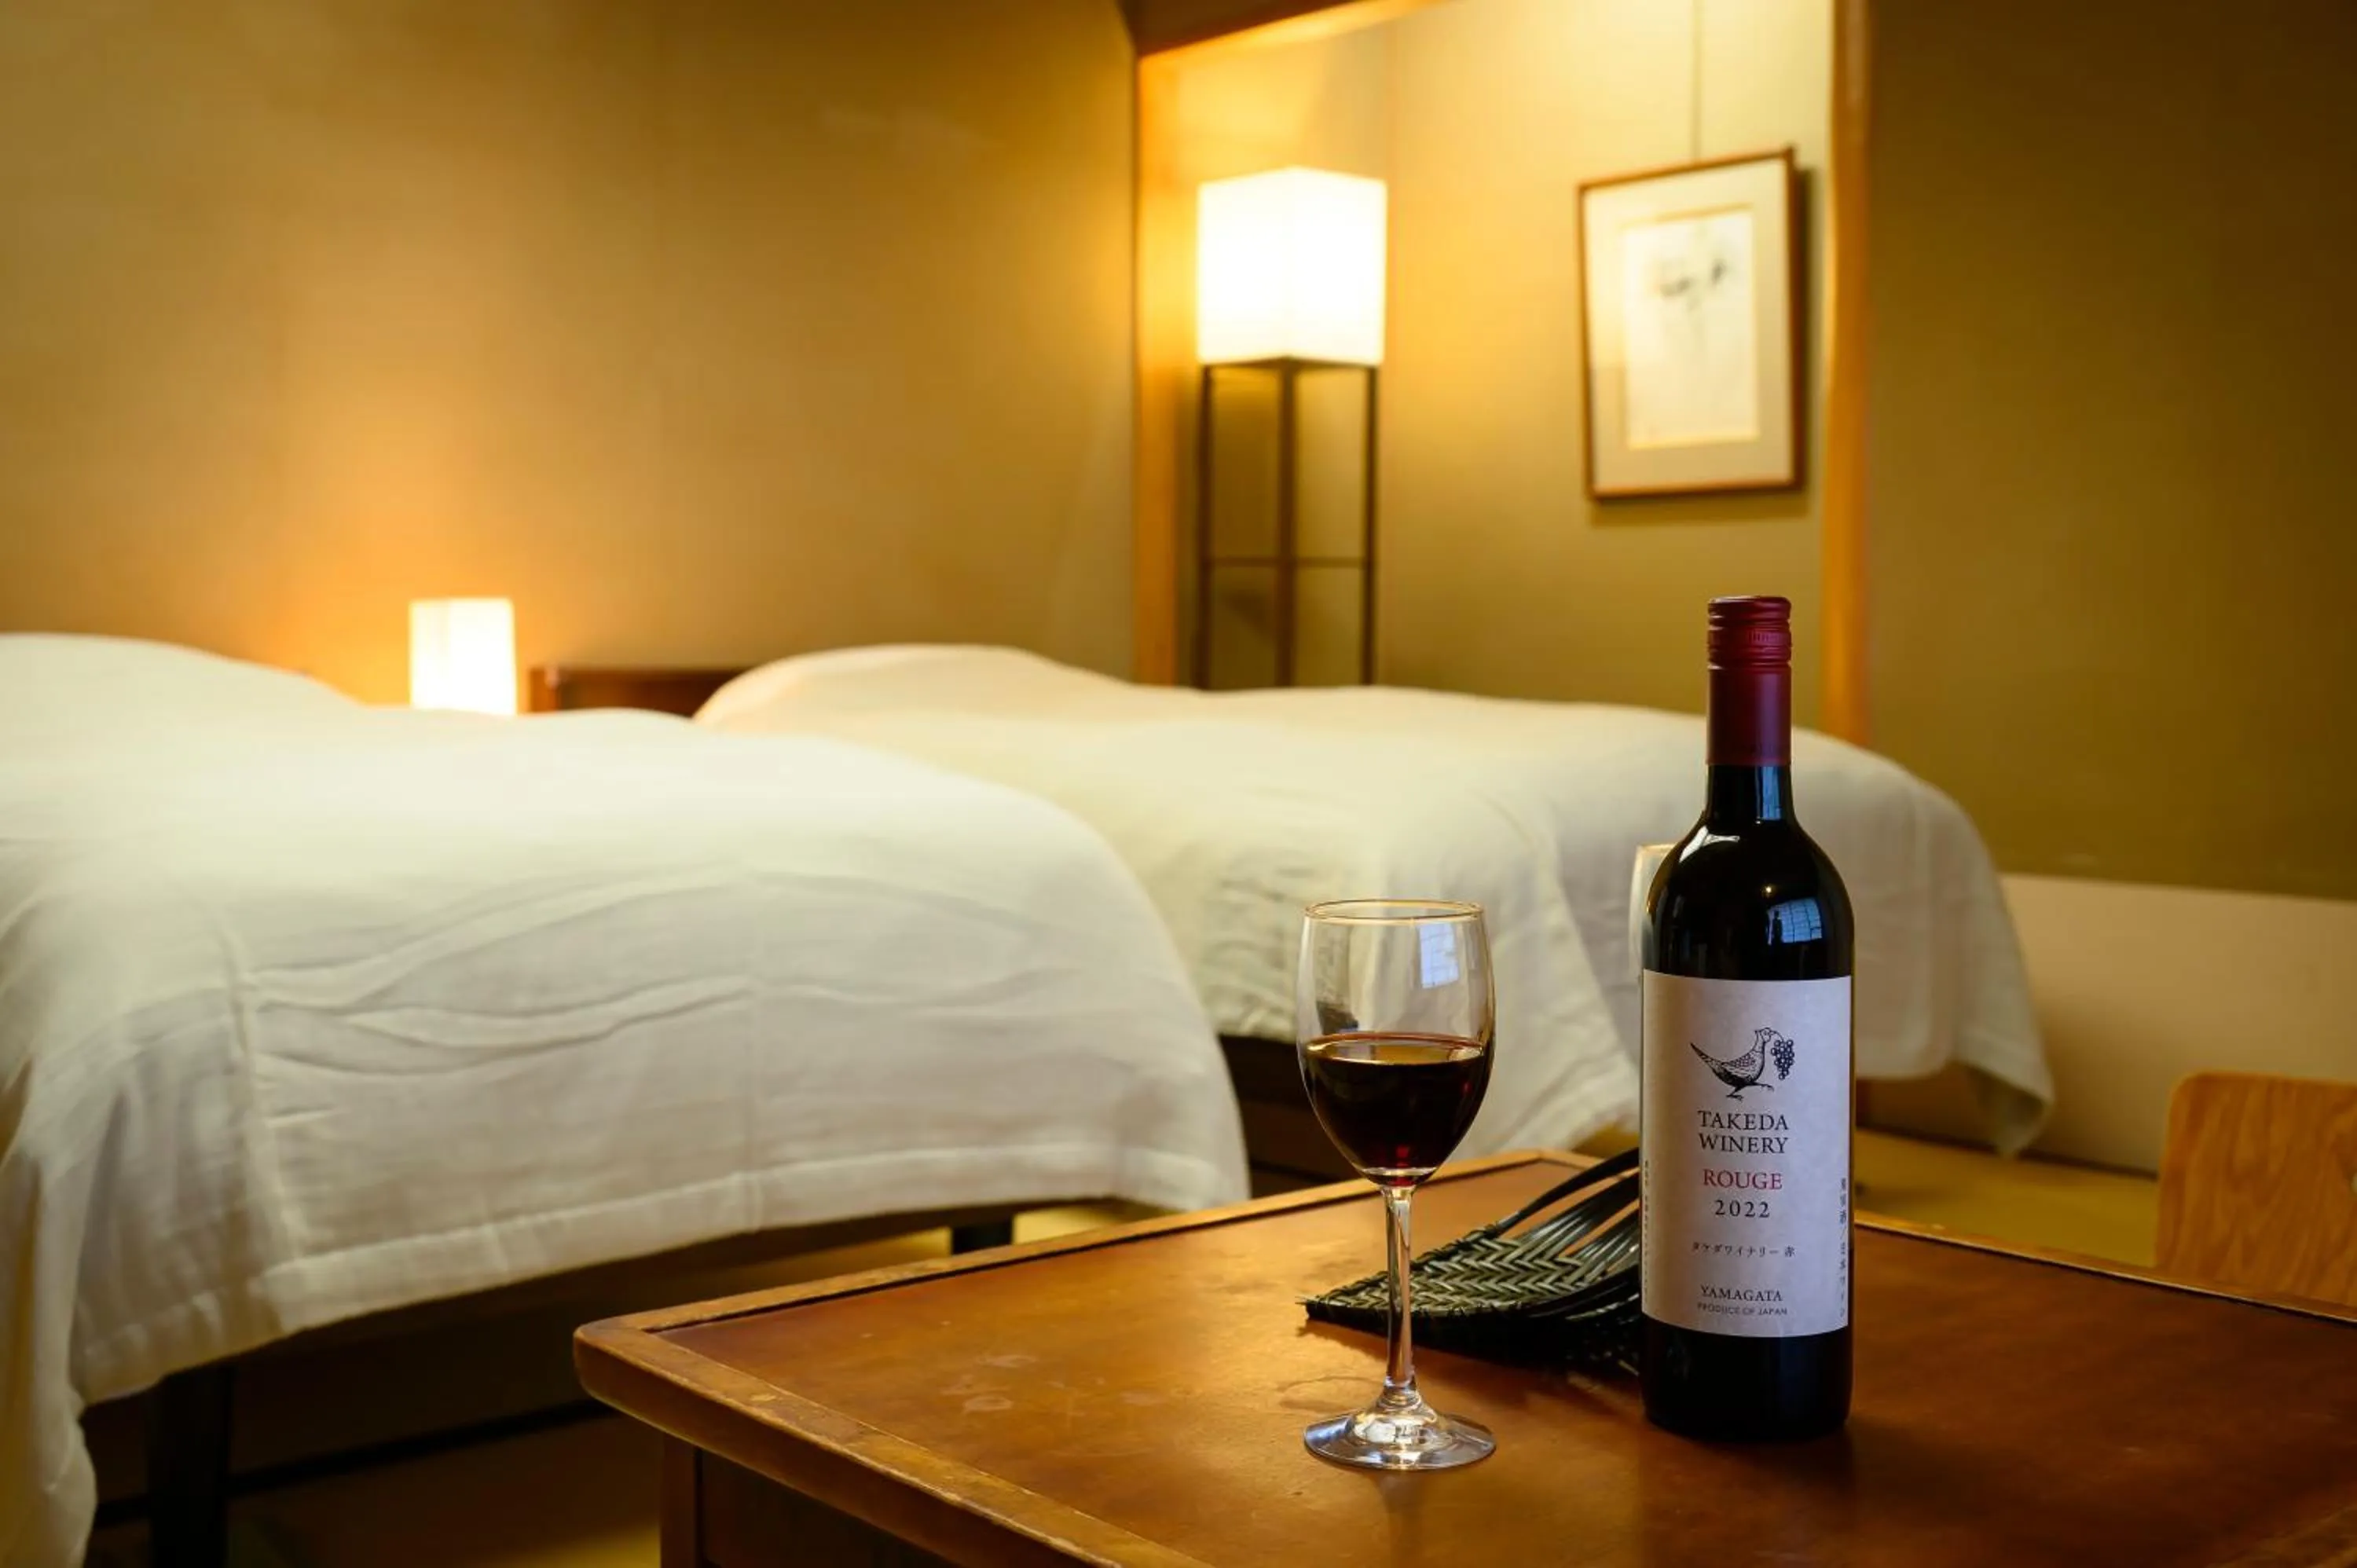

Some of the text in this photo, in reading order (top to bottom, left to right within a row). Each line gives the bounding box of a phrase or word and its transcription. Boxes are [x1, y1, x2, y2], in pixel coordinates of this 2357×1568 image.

[1697, 1110, 1789, 1131] TAKEDA
[1698, 1133, 1789, 1154] WINERY
[1703, 1169, 1783, 1190] ROUGE
[1714, 1200, 1770, 1218] 2022
[1700, 1284, 1783, 1302] YAMAGATA
[1758, 1307, 1787, 1316] JAPAN
